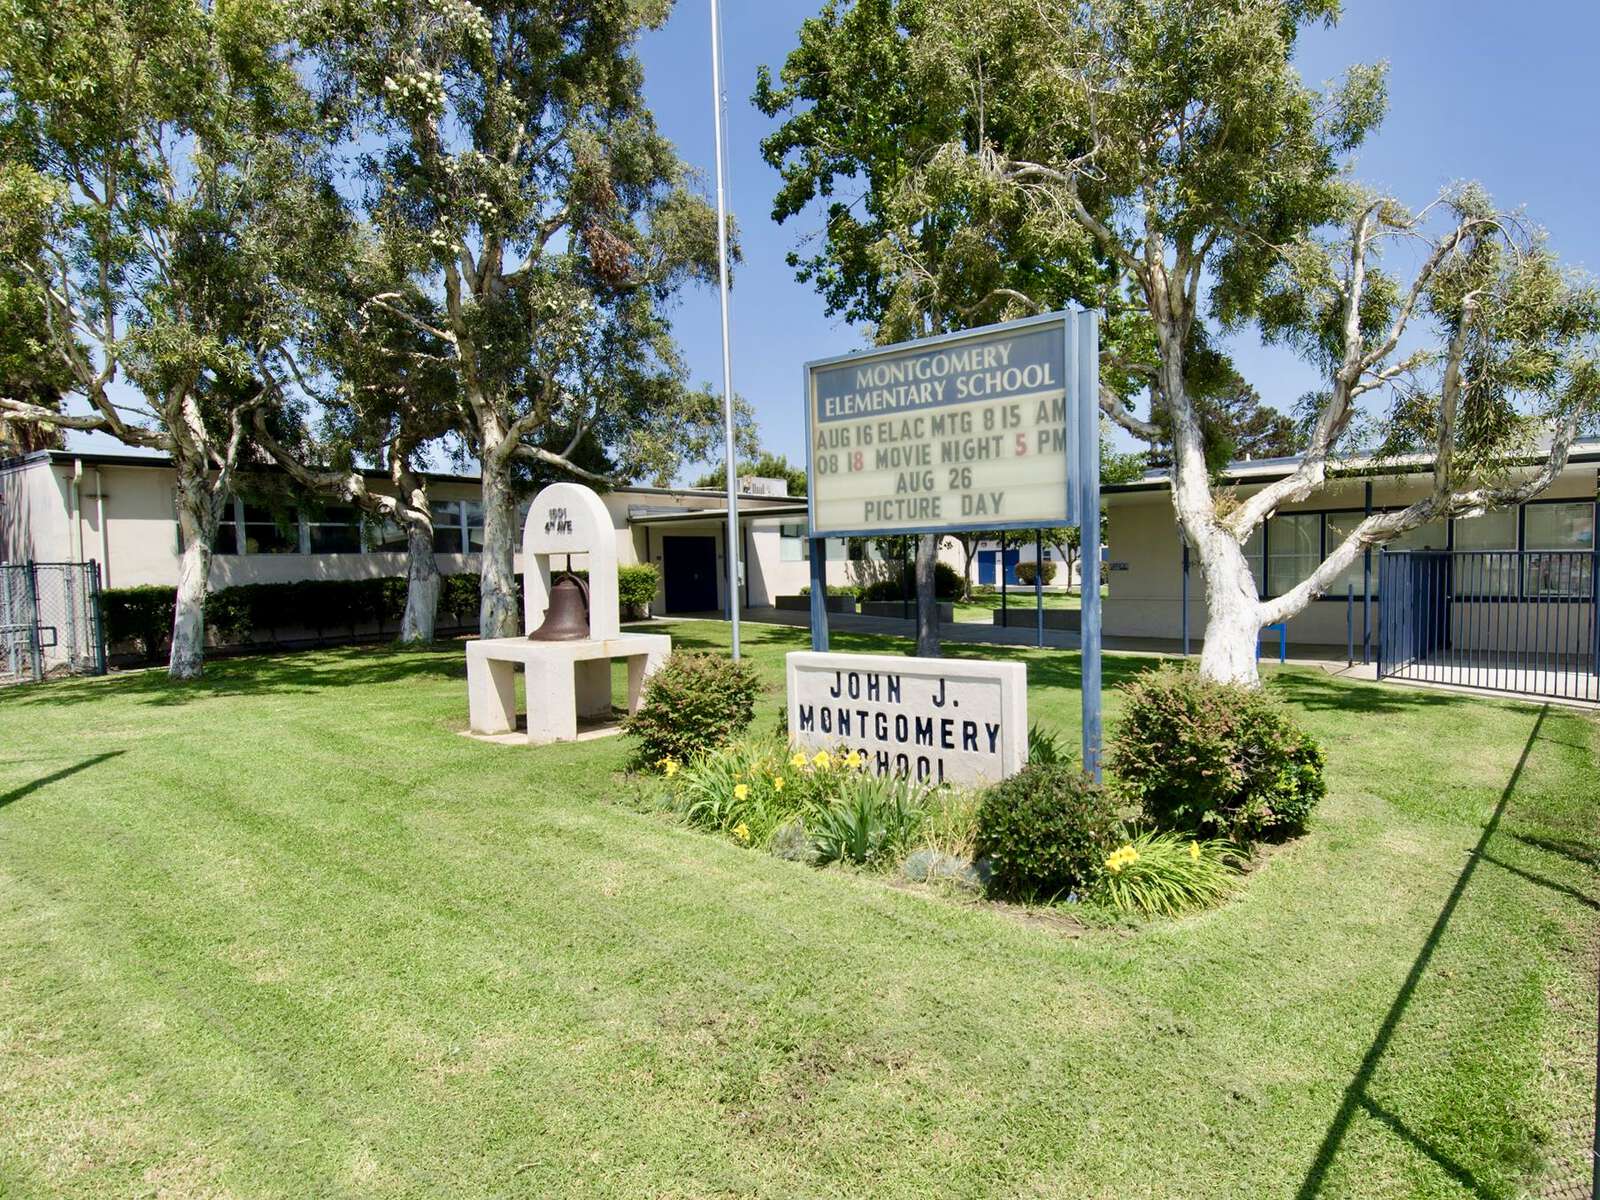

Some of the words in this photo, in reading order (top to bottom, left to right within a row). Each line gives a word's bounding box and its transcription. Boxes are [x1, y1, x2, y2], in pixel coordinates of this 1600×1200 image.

[856, 344, 1012, 389] MONTGOMERY
[825, 381, 946, 417] ELEMENTARY
[957, 362, 1055, 399] SCHOOL
[817, 429, 850, 450] AUG
[856, 425, 873, 446] 16
[879, 417, 925, 441] ELAC
[931, 411, 972, 437] MTG
[1035, 397, 1066, 425] AM
[817, 454, 838, 475] 08
[847, 451, 864, 473] 18
[876, 443, 931, 469] MOVIE
[941, 435, 1004, 463] NIGHT
[1015, 432, 1027, 456] 5
[1037, 428, 1066, 454] PM
[896, 470, 935, 494] AUG
[949, 467, 972, 490] 26
[864, 497, 941, 522] PICTURE
[961, 492, 1005, 516] DAY
[830, 671, 901, 704] JOHN
[931, 678, 959, 708] J.
[799, 704, 1001, 754] MONTGOMERY
[843, 748, 944, 786] CHOOL
